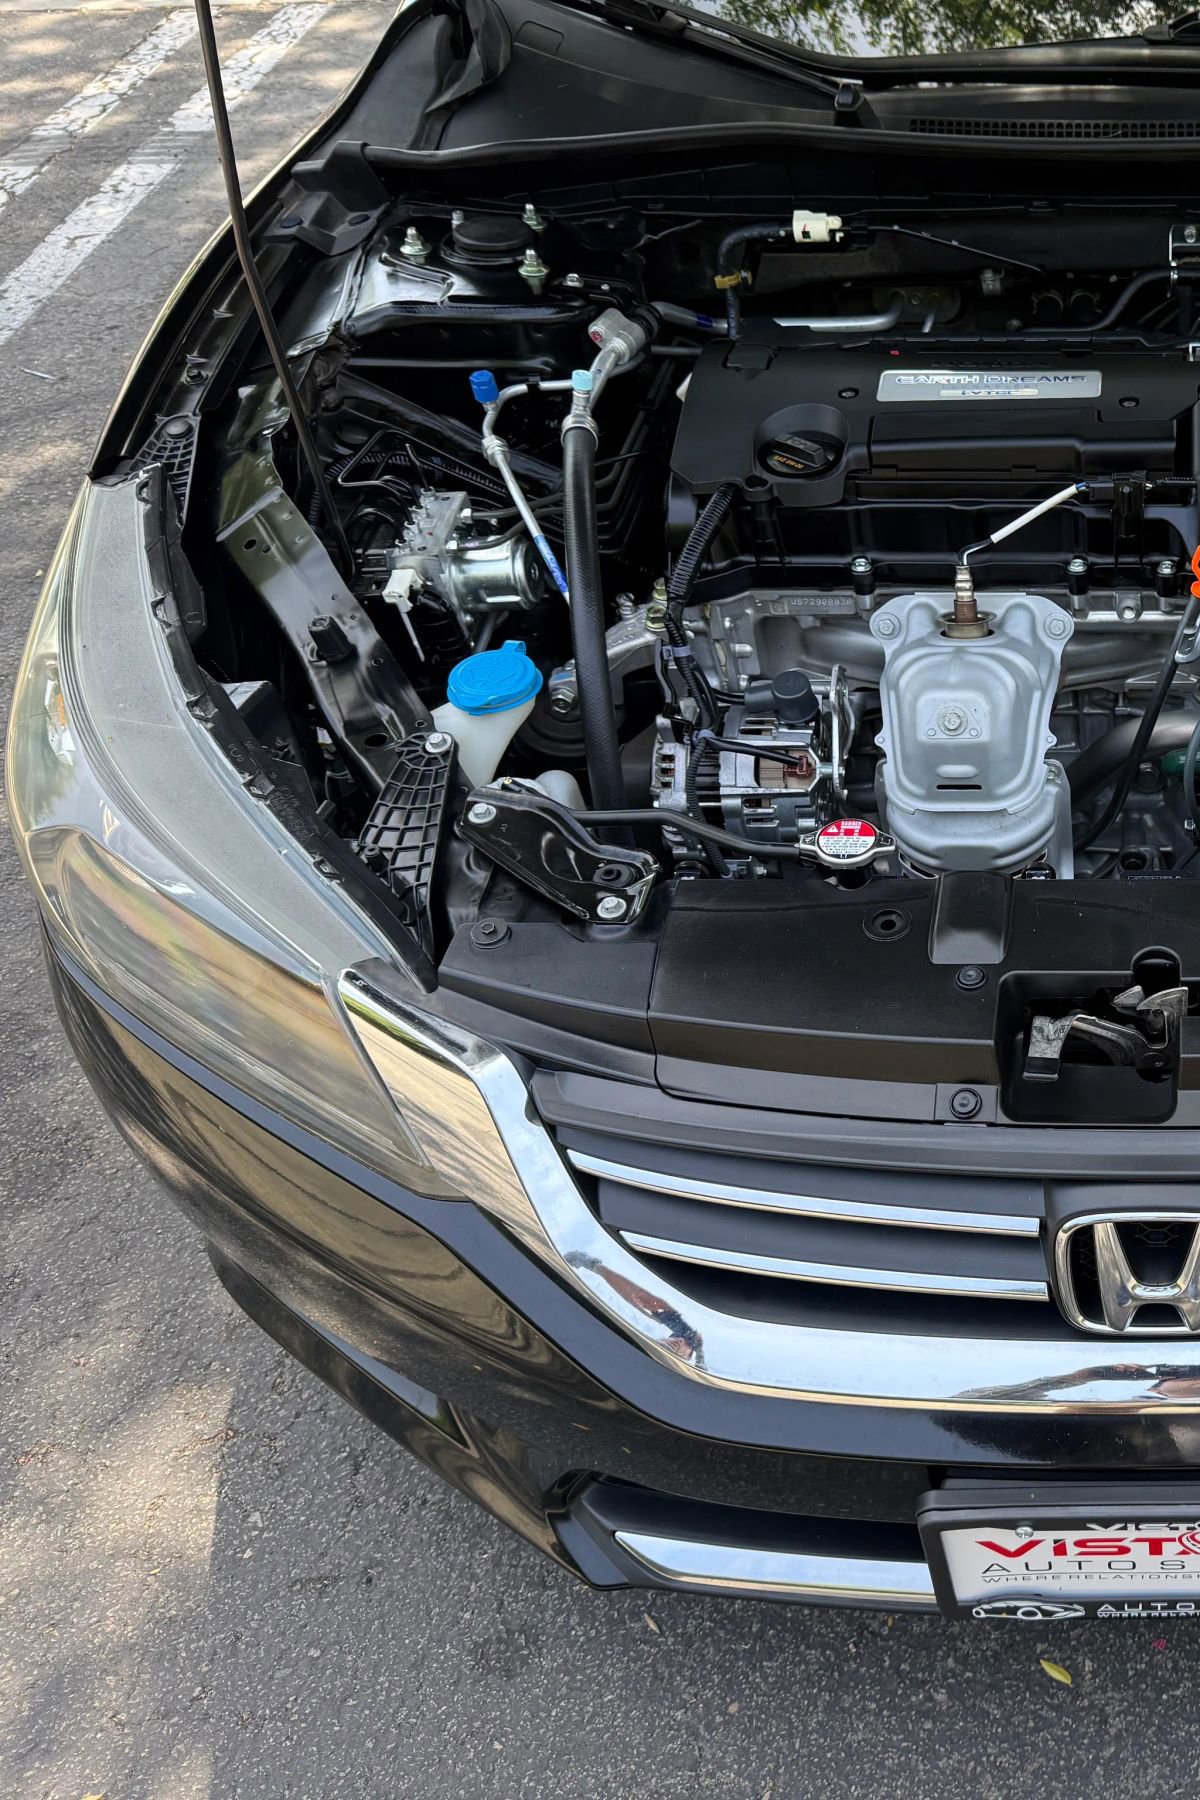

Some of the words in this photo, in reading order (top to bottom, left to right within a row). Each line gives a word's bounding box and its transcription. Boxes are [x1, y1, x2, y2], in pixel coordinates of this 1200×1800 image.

[895, 375, 980, 385] EARTH
[984, 375, 1087, 385] DREAMS
[981, 1560, 1136, 1575] AUTO
[982, 1574, 1061, 1583] WHERE
[1098, 1602, 1195, 1612] AUTO
